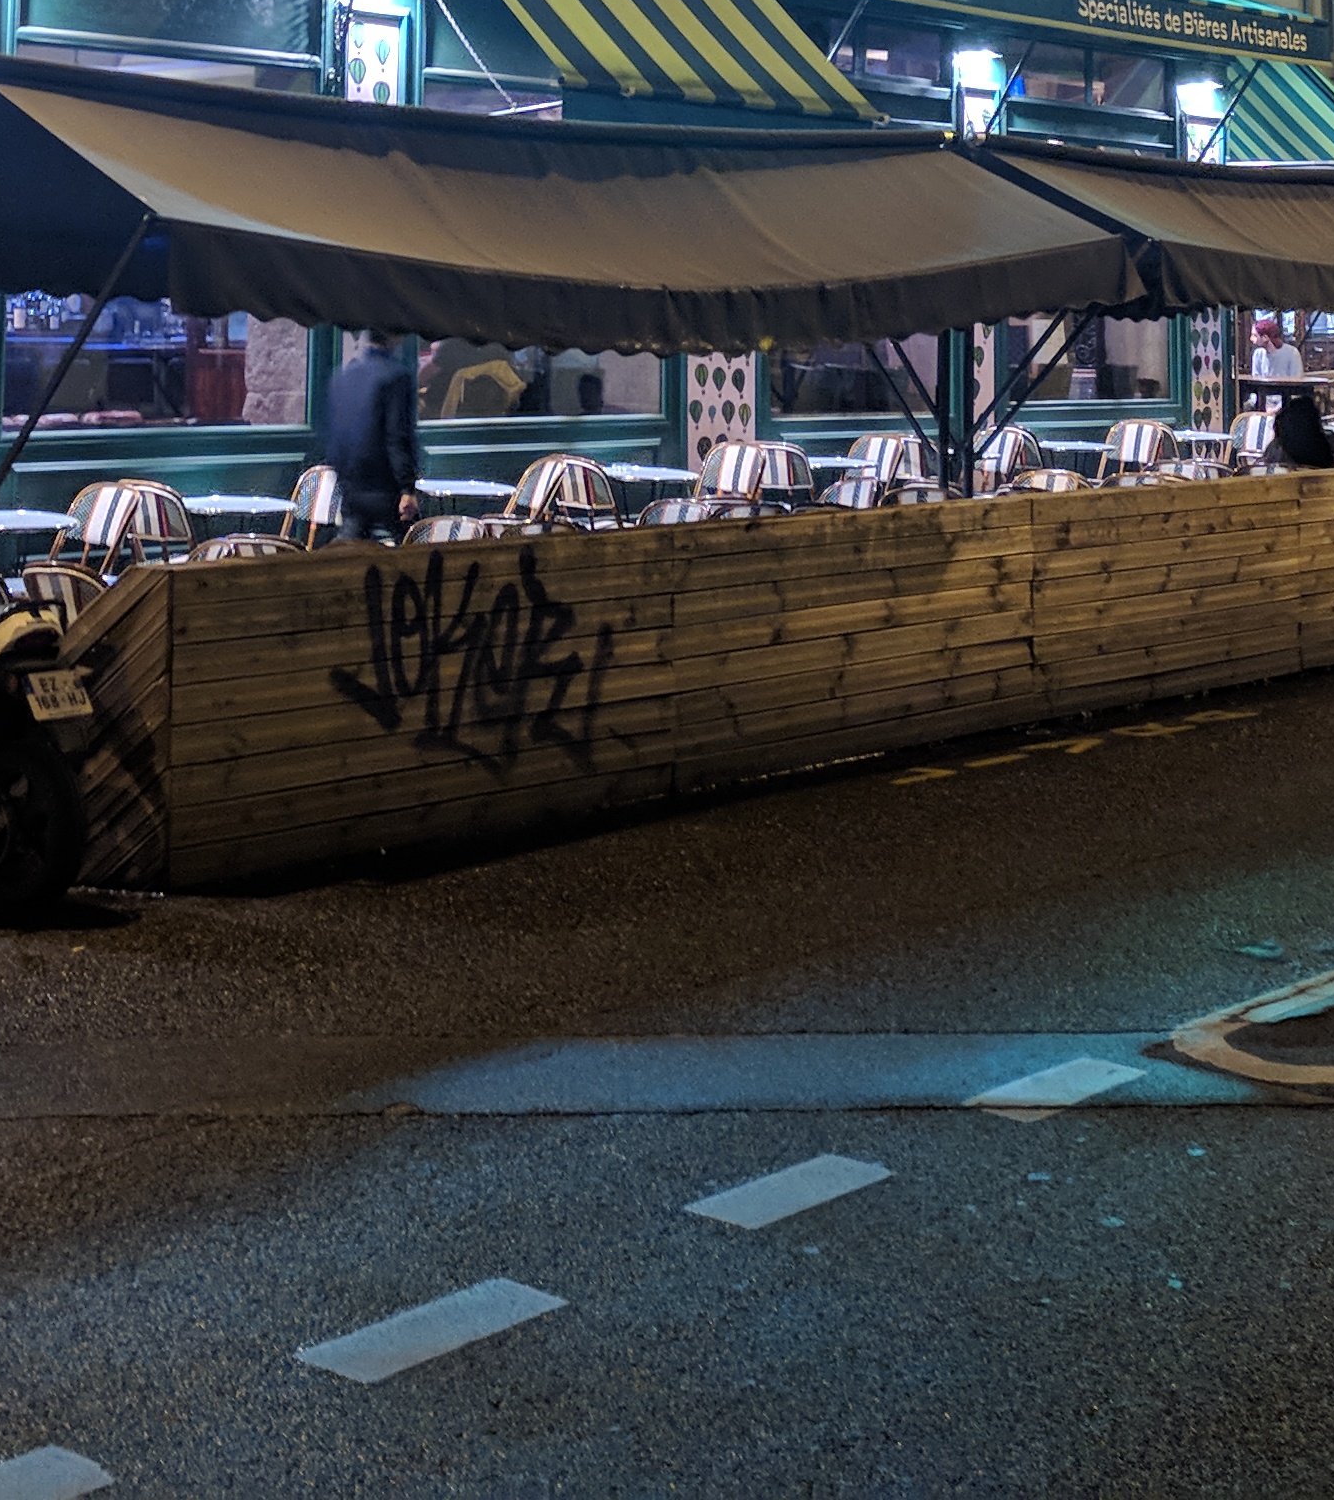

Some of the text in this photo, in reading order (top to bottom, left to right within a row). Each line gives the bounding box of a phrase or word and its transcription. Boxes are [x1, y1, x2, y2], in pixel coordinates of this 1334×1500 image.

[1164, 8, 1182, 33] de
[1183, 10, 1229, 42] Bières
[1230, 19, 1309, 52] Artisanales
